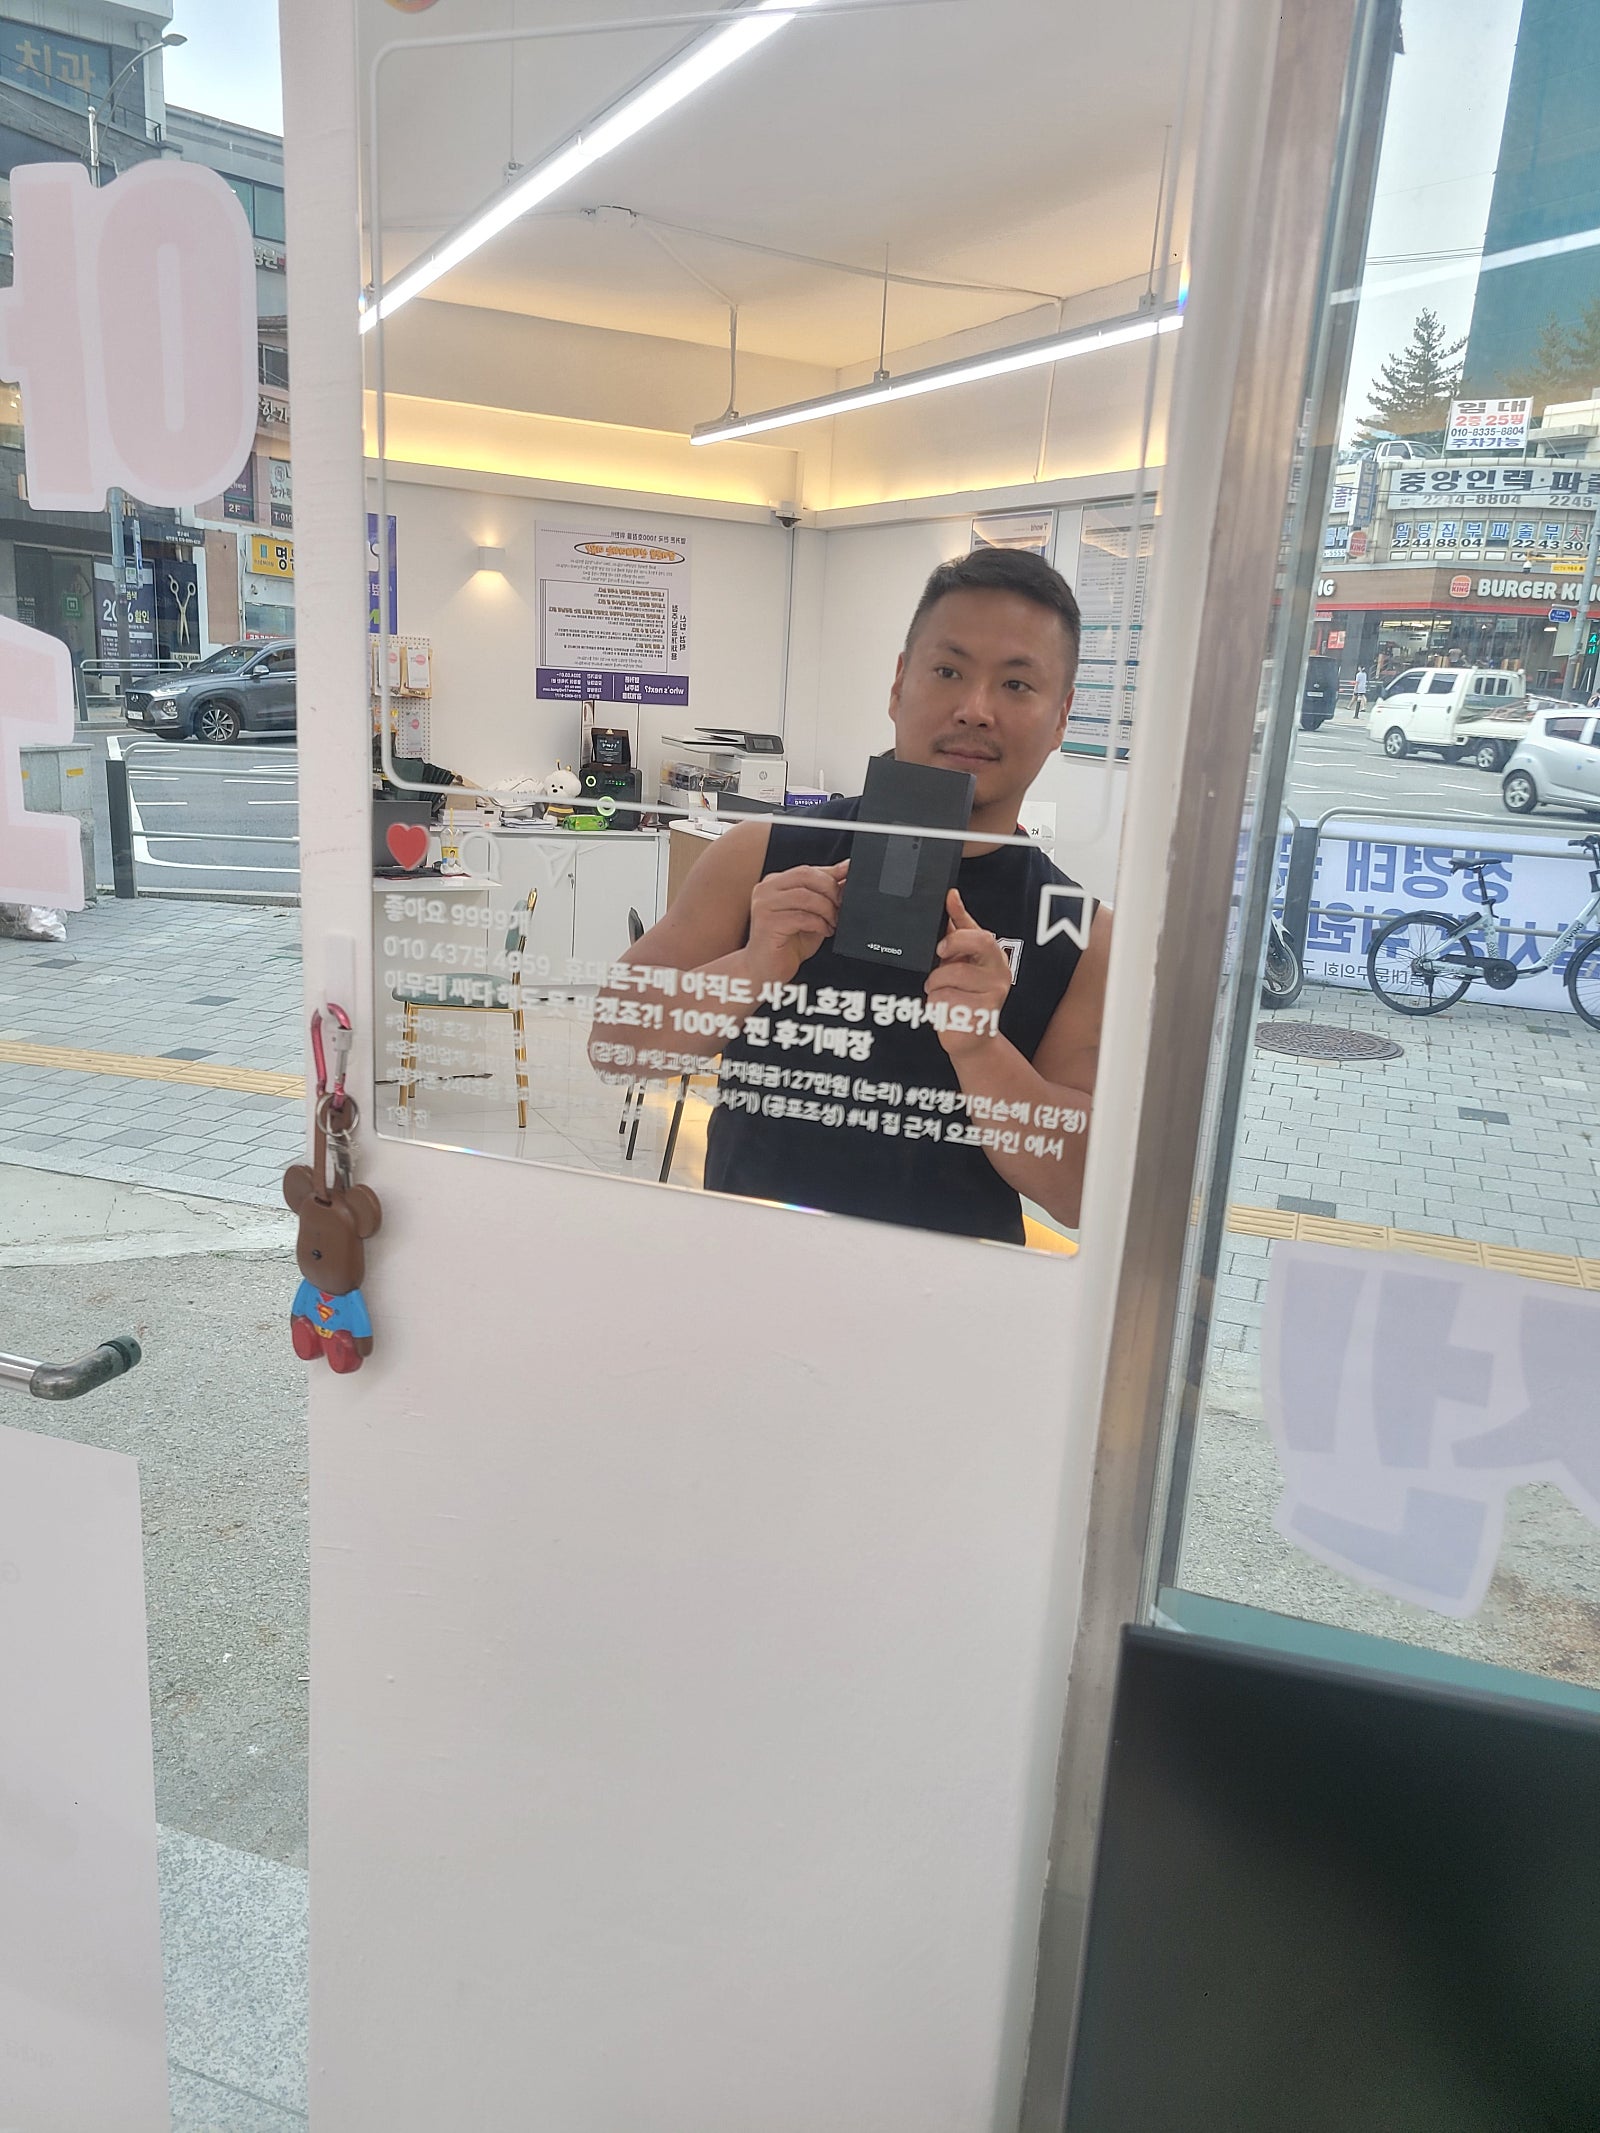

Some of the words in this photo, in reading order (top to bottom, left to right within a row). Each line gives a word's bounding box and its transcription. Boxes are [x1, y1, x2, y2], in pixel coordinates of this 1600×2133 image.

[16, 40, 95, 92] 치과
[1486, 414, 1524, 425] 25평
[1451, 427, 1524, 436] 010-8335-8804
[1452, 438, 1520, 448] 주차가능
[229, 504, 240, 513] 2F
[1423, 494, 1522, 506] 2244-8804
[1478, 579, 1557, 600] BURGER
[135, 610, 149, 624] 할인
[384, 894, 447, 924] 좋아요
[451, 904, 531, 939] 9999개
[1563, 922, 1584, 945] SWING
[383, 936, 425, 960] 010
[430, 941, 488, 968] 4375
[681, 970, 755, 1008] 아직도
[758, 981, 866, 1021] 사기,호갱
[870, 995, 1001, 1039] 당하세요?!
[383, 970, 447, 1004] 아무리
[451, 977, 493, 1008] 싸다
[497, 983, 541, 1010] 해도
[575, 994, 665, 1030] 믿겠죠?!
[669, 1007, 743, 1041] 100%
[743, 1018, 772, 1049] 찐
[774, 1020, 875, 1063] 후기매장
[853, 1077, 903, 1106] (논리)
[903, 1087, 1030, 1125] #안챙기면손해
[1033, 1109, 1088, 1135] (감정)
[761, 1094, 845, 1127] (공포조성)
[847, 1110, 878, 1133] #내
[881, 1114, 901, 1135] 집
[903, 1119, 942, 1143] 근처
[943, 1123, 1020, 1154] 오프라인
[1024, 1134, 1064, 1161] 에서
